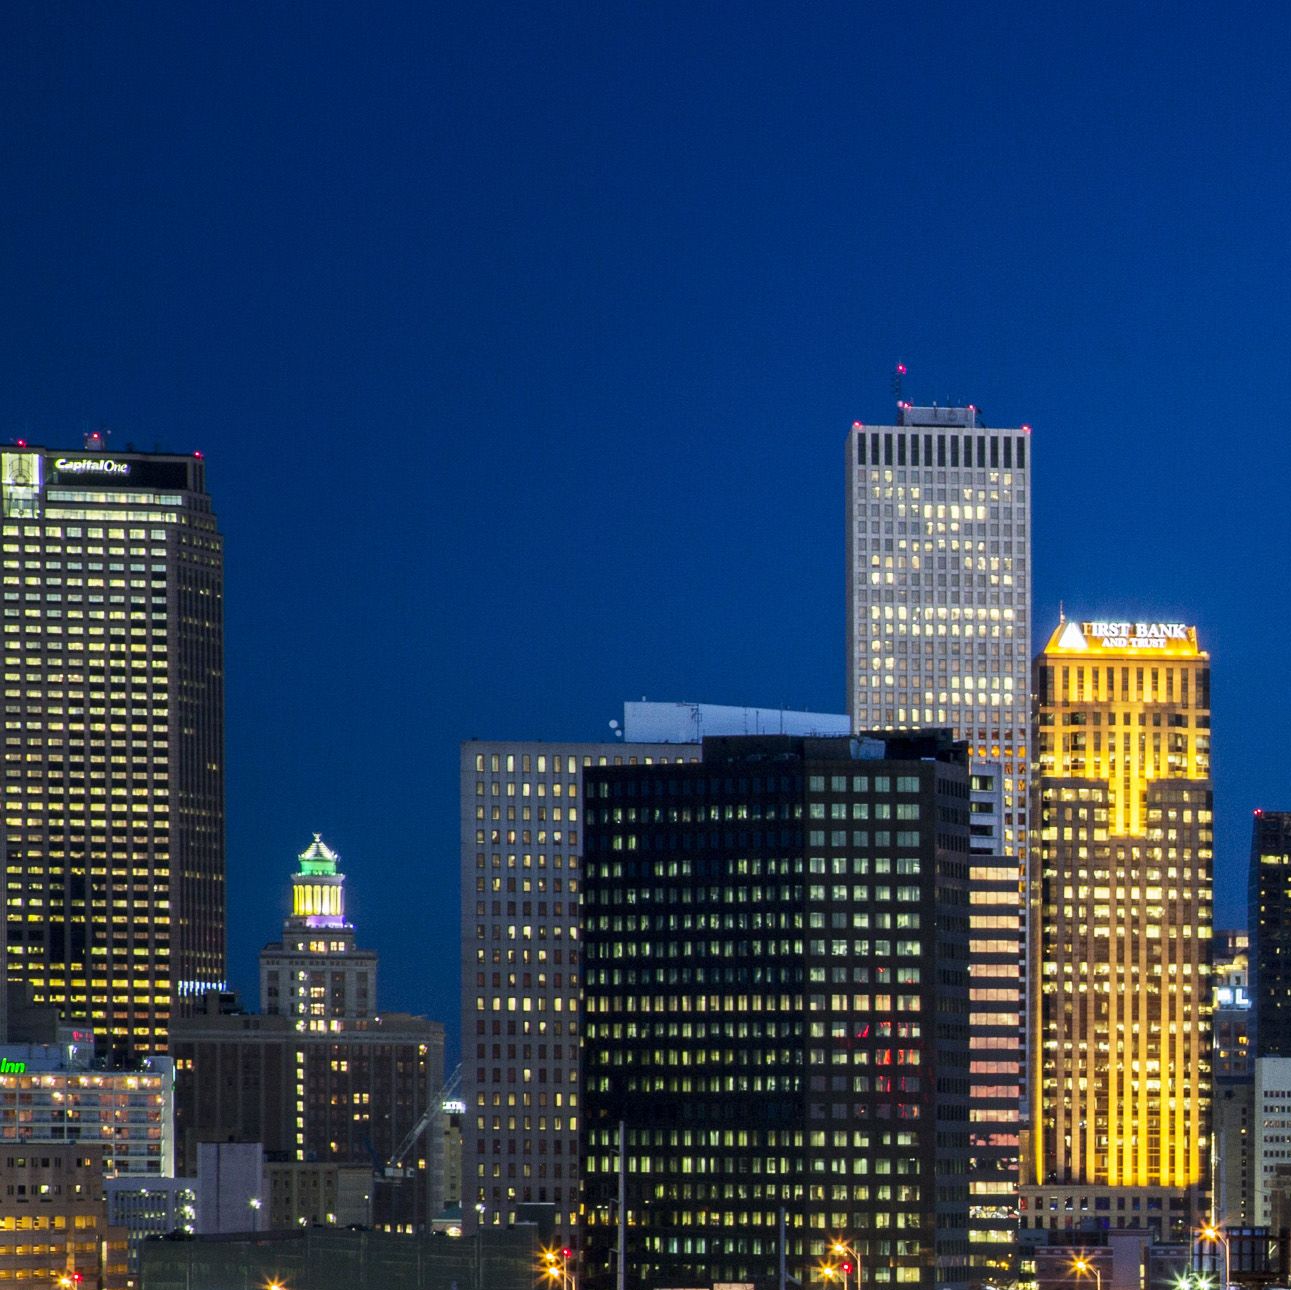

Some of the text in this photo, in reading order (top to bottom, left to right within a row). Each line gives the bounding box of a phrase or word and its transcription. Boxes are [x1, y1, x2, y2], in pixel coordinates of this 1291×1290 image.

[1082, 622, 1187, 638] FIRST BANK
[1102, 637, 1167, 648] AND TRUST
[1, 1057, 26, 1073] Inn
